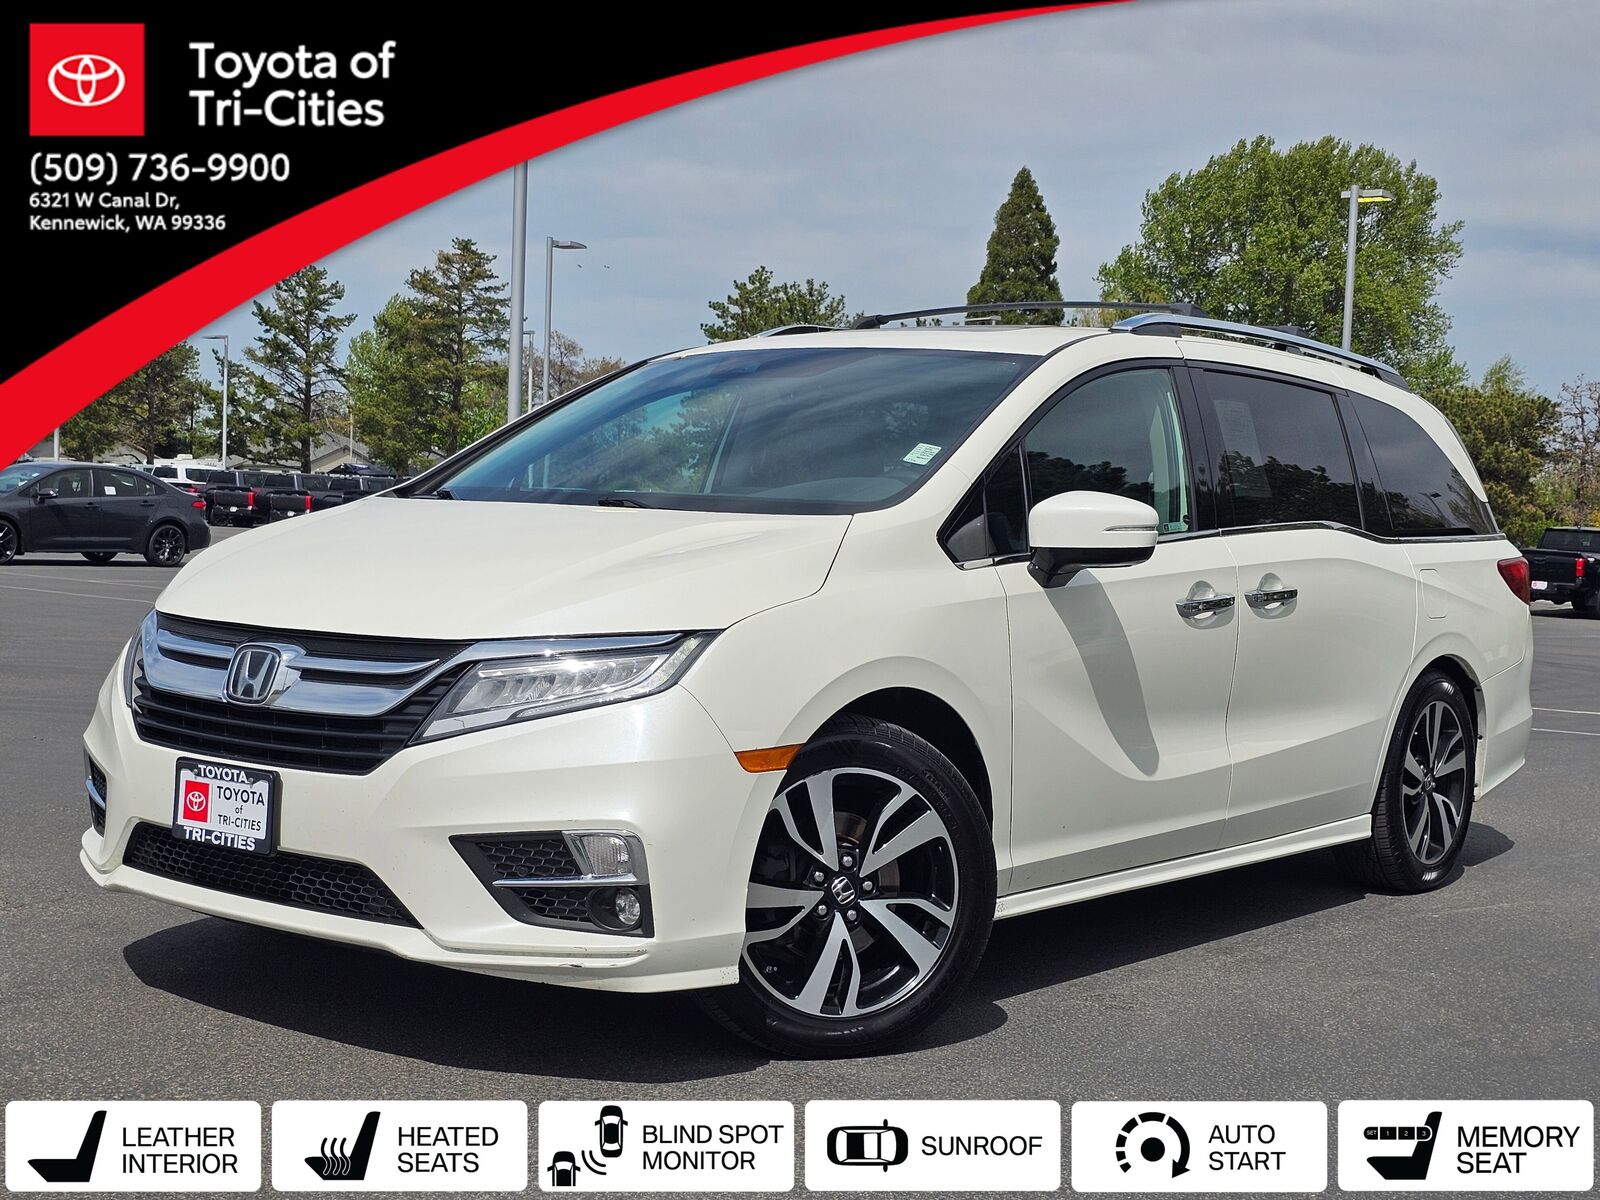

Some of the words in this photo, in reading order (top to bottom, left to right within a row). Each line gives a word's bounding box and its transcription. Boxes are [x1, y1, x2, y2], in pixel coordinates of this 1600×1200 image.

[198, 764, 249, 783] TOYOTA
[217, 786, 265, 806] TOYOTA
[235, 805, 244, 815] of
[218, 814, 262, 832] TRI-CITIES
[184, 825, 256, 851] TRI-CITIES
